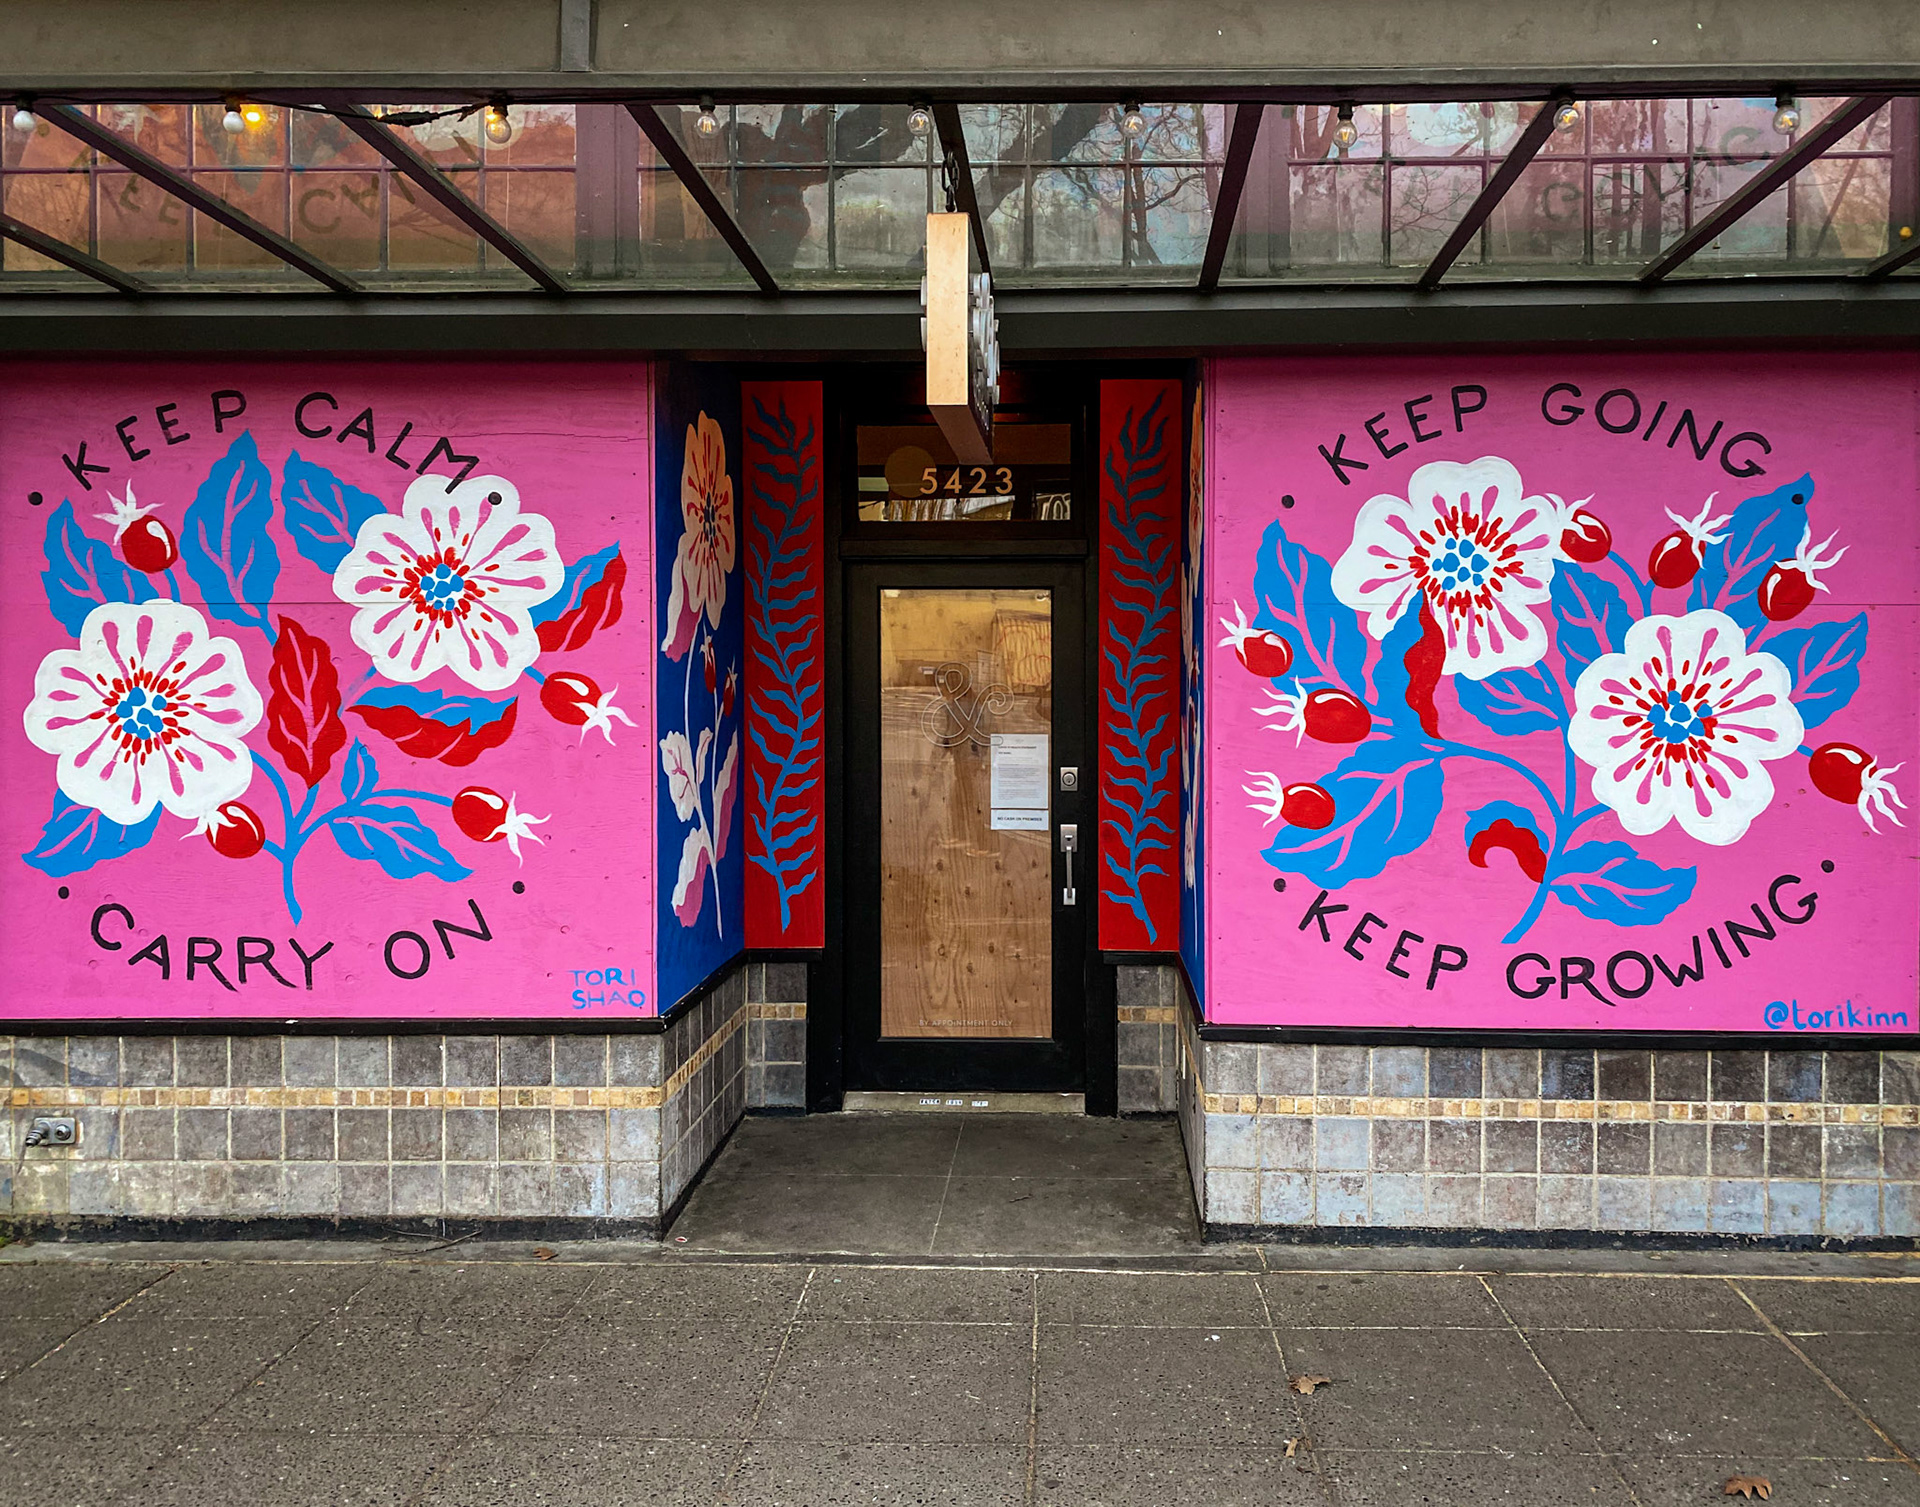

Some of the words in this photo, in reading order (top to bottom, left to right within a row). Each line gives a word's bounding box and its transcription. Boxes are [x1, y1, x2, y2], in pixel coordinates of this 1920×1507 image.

[62, 390, 247, 491] KEEP
[294, 392, 480, 494] CALM
[1318, 384, 1488, 486] KEEP
[1541, 382, 1772, 478] GOING
[919, 467, 1013, 494] 5423
[90, 903, 335, 992] CARRY
[384, 898, 493, 980] ON
[1298, 889, 1468, 991] KEEP
[1506, 874, 1819, 1007] GROWING
[567, 967, 636, 987] TORI
[919, 1019, 929, 1027] BY
[932, 1019, 988, 1027] APPOINTMENT
[991, 1019, 1013, 1027] ONLY
[1764, 999, 1908, 1030] @torikinn
